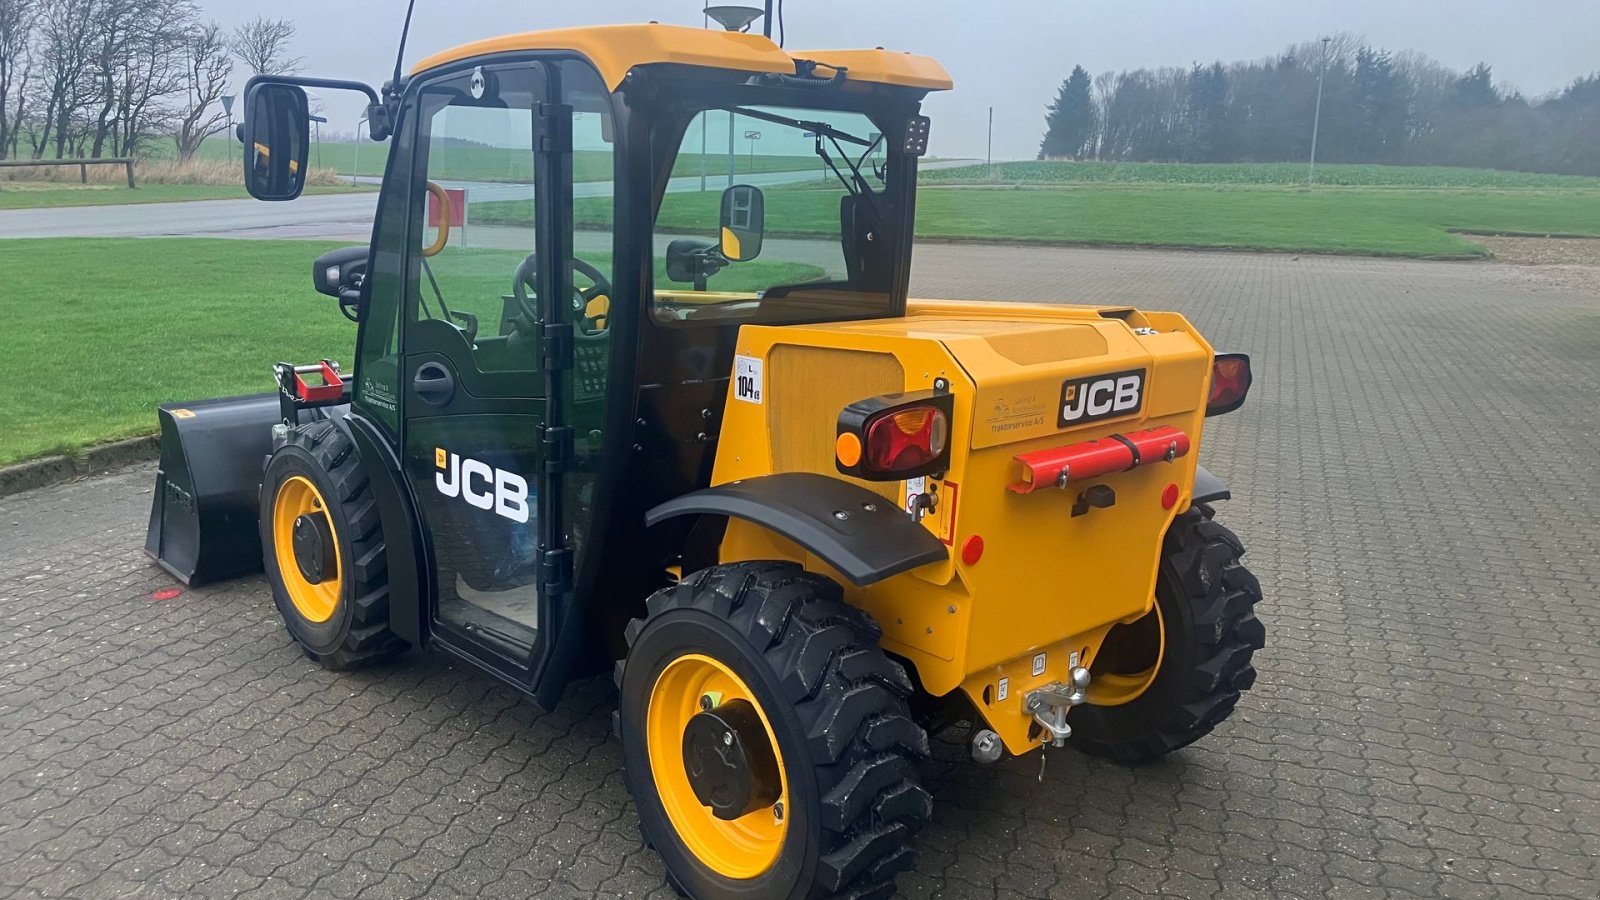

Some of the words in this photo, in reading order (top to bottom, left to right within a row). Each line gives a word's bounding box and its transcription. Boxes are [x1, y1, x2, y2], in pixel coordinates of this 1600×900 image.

[738, 375, 753, 398] 104
[1063, 375, 1141, 421] JCB
[991, 419, 1033, 432] Traktorservice
[1033, 416, 1045, 426] A/S
[435, 452, 530, 524] JCB
